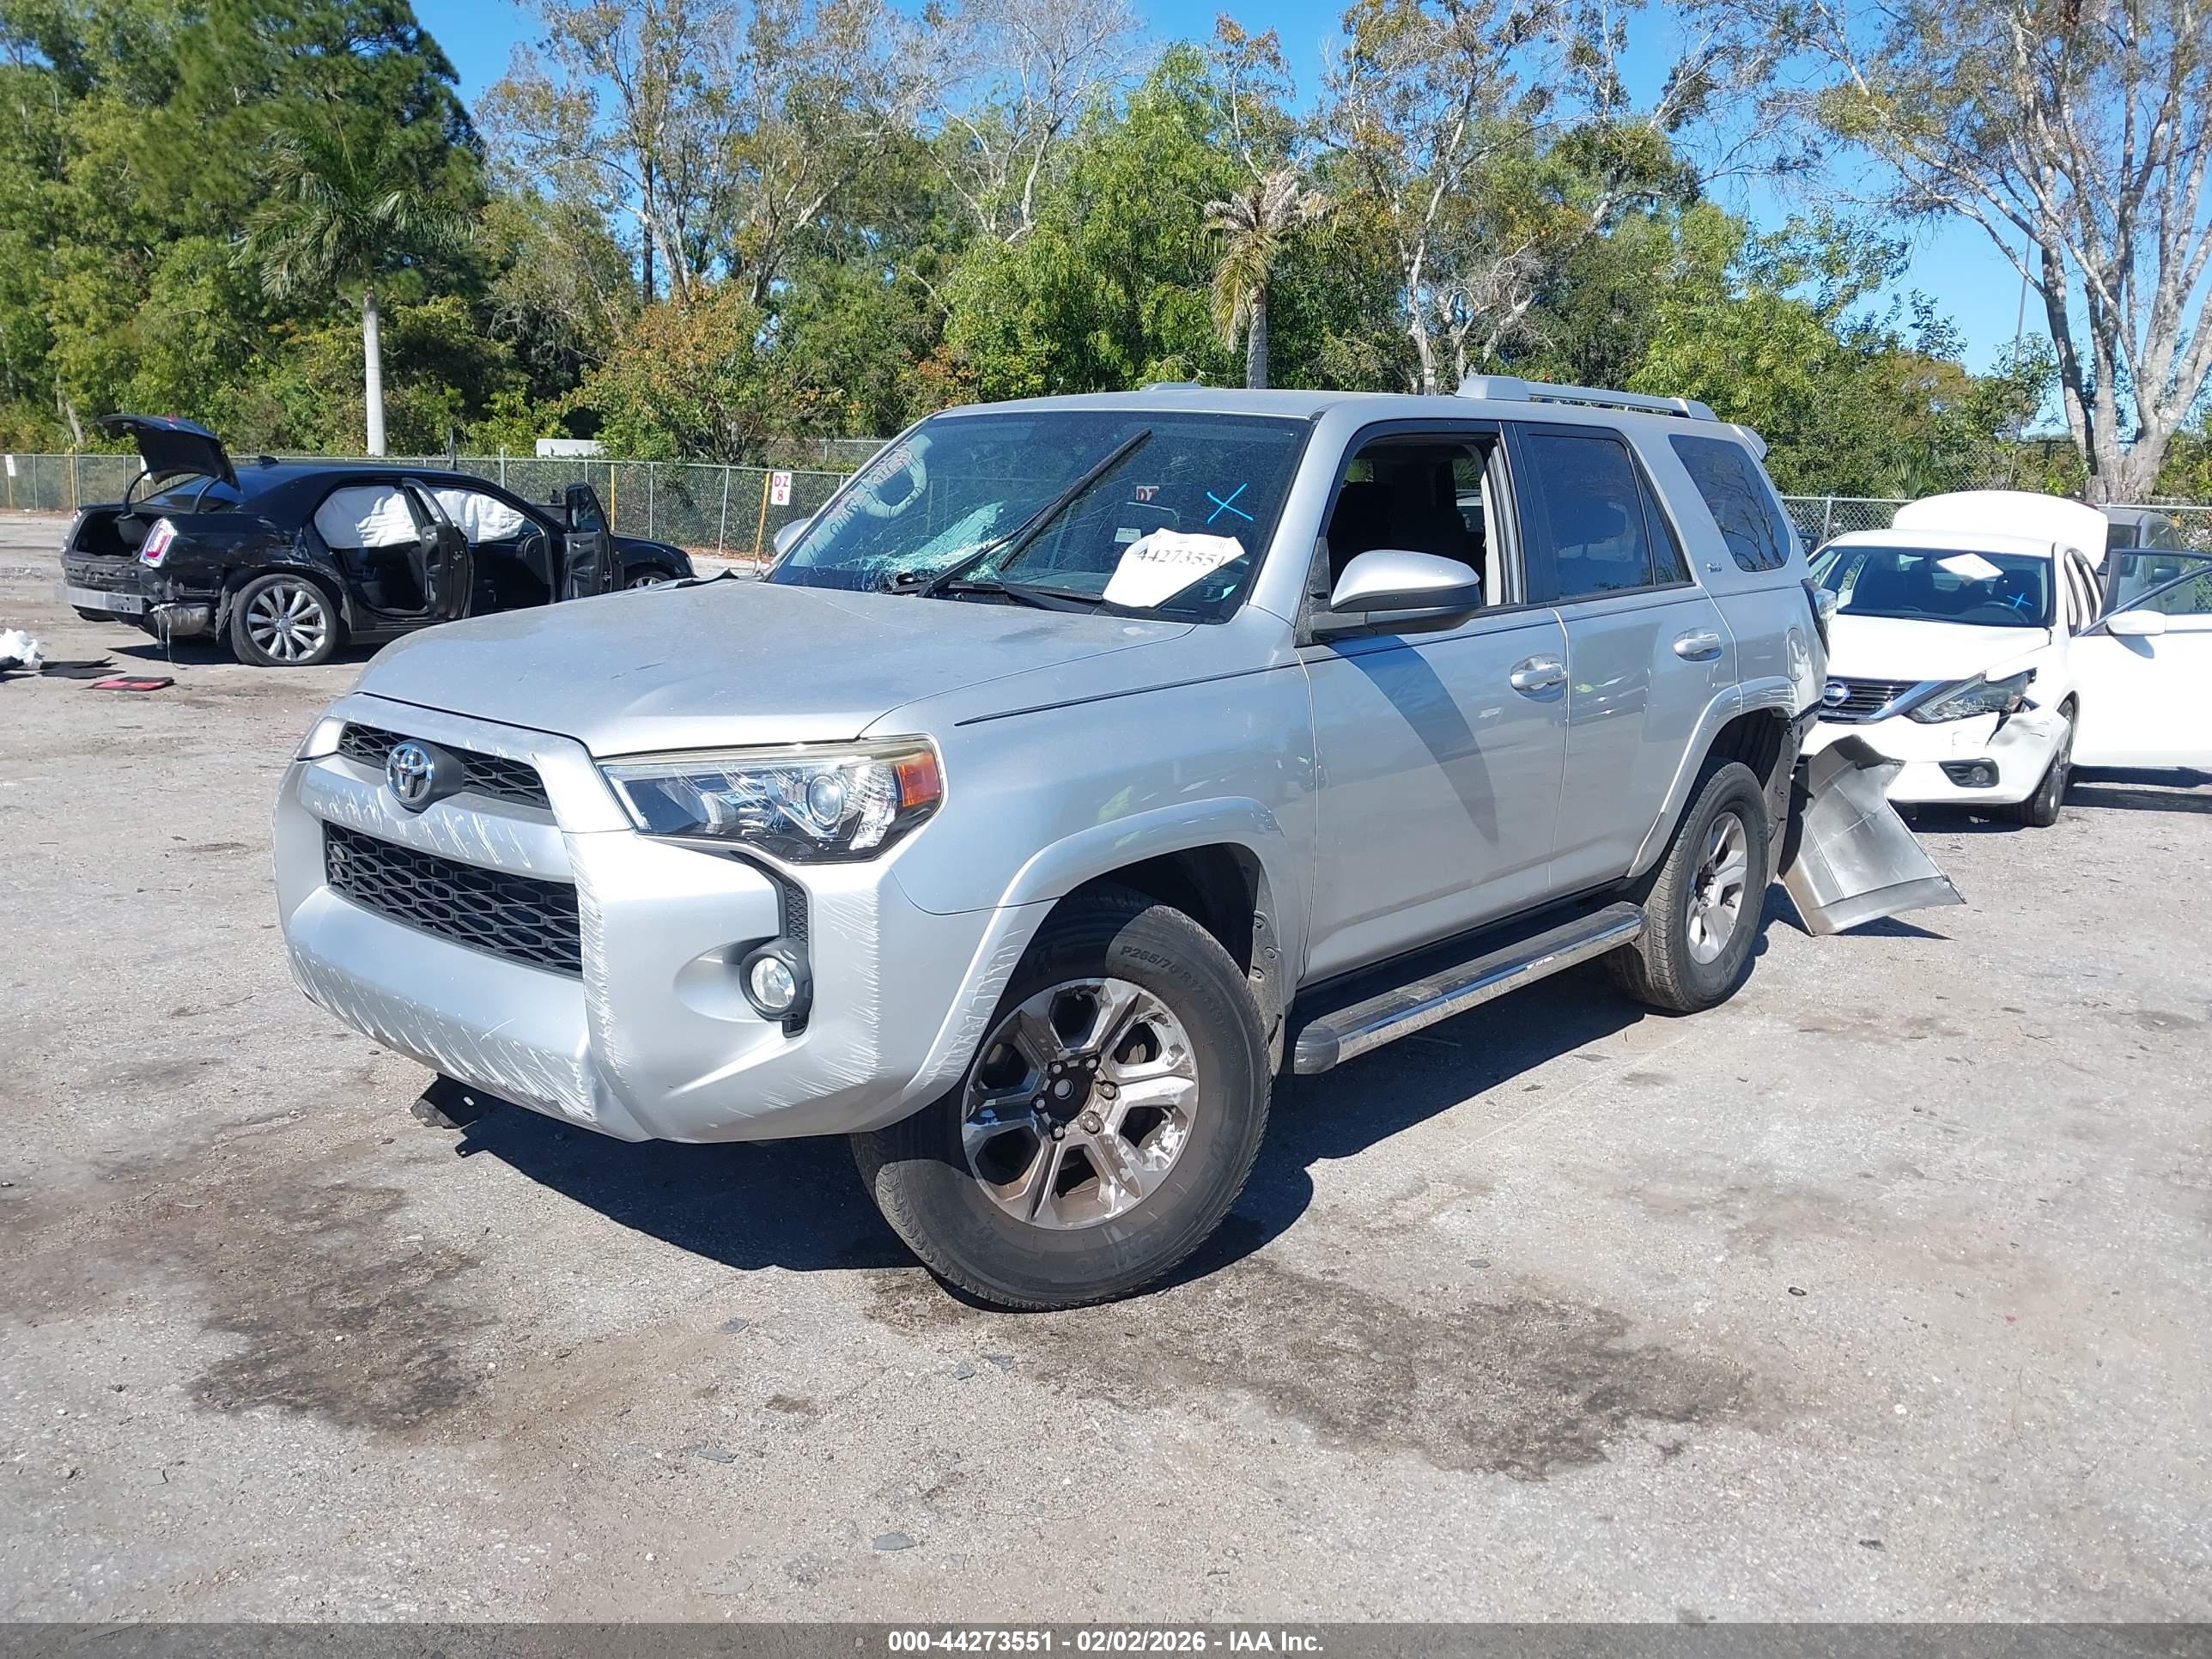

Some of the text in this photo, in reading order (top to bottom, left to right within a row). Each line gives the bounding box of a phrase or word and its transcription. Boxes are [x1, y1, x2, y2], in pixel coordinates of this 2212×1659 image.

[774, 475, 789, 488] DZ
[777, 489, 784, 501] 8
[1135, 548, 1226, 568] 44273551
